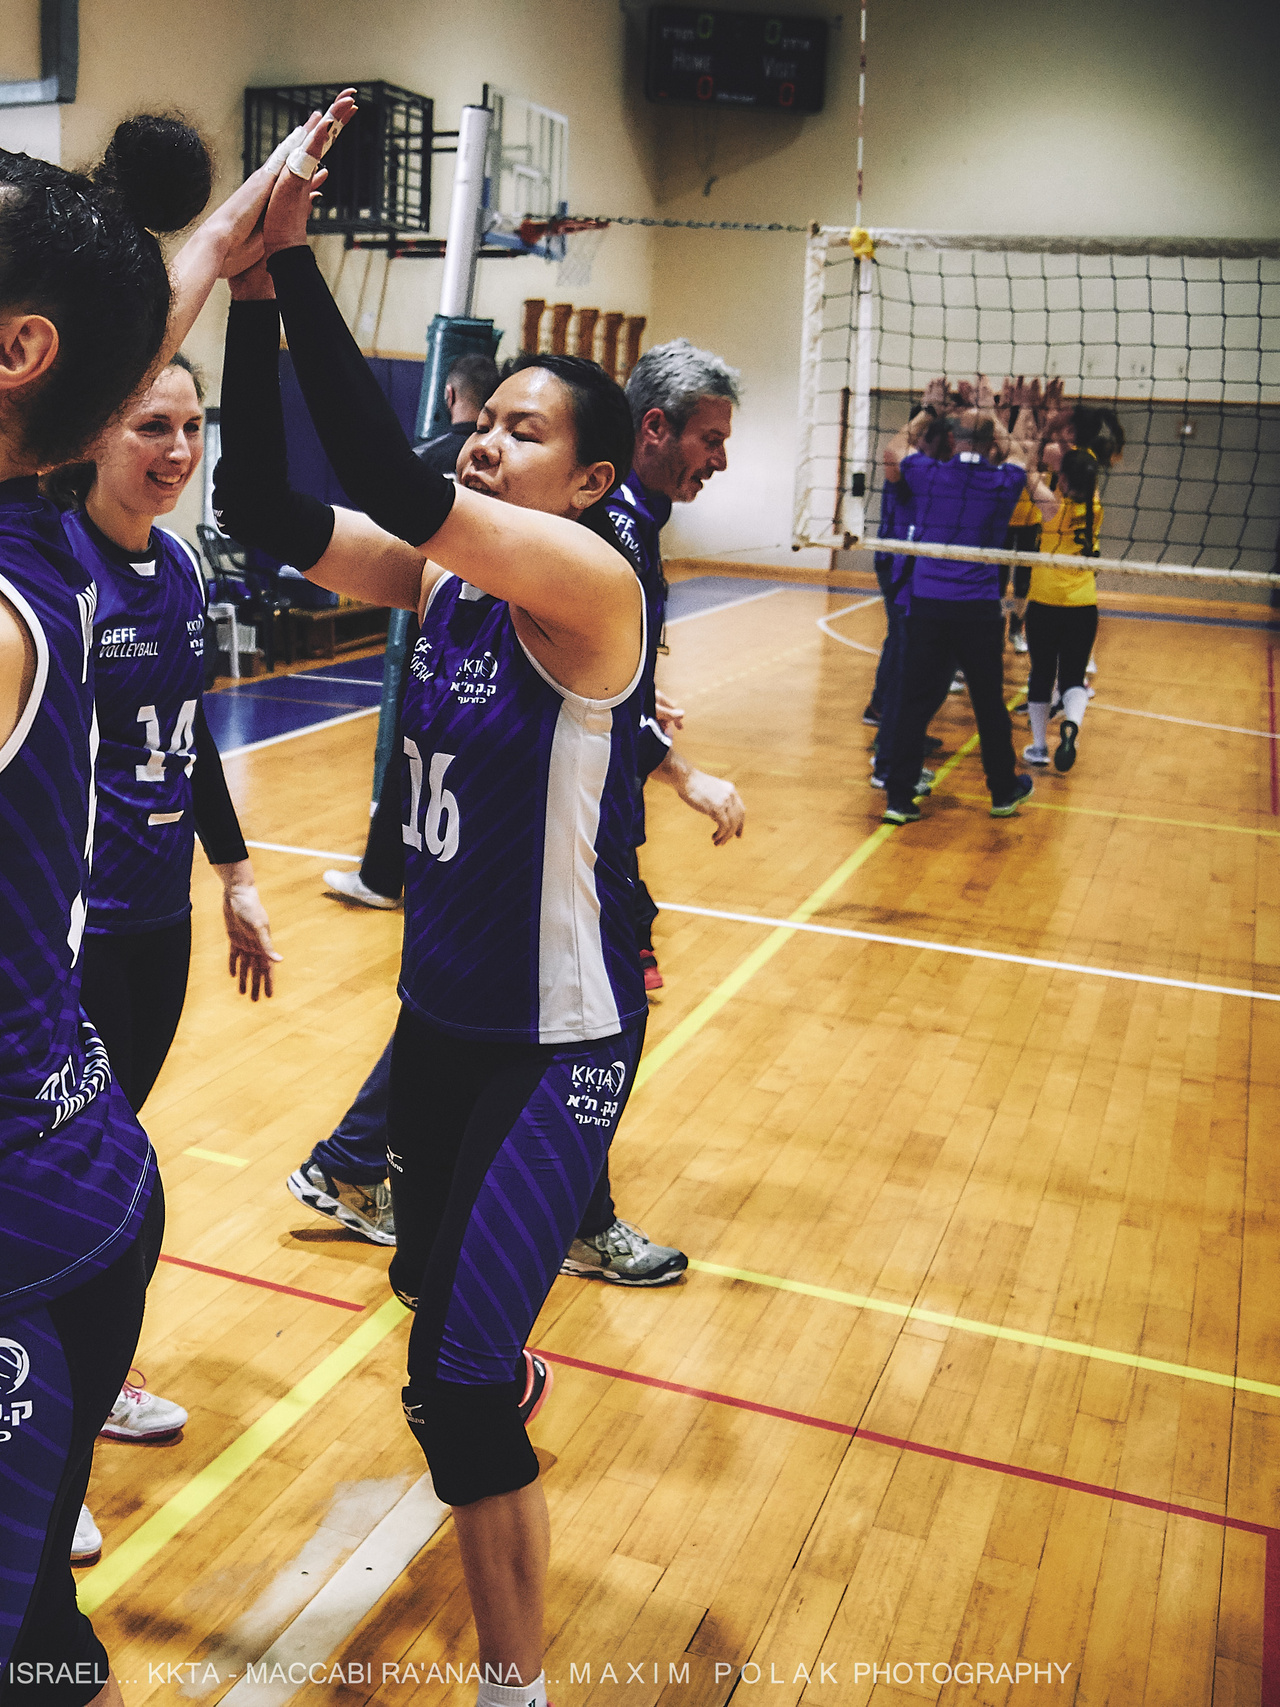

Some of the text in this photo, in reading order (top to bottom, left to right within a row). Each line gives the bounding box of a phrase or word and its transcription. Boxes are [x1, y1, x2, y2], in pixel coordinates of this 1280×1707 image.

[100, 627, 137, 645] GEFF
[99, 641, 159, 659] VOLLEYBALL
[401, 735, 460, 863] 16
[571, 1064, 612, 1087] KKTA
